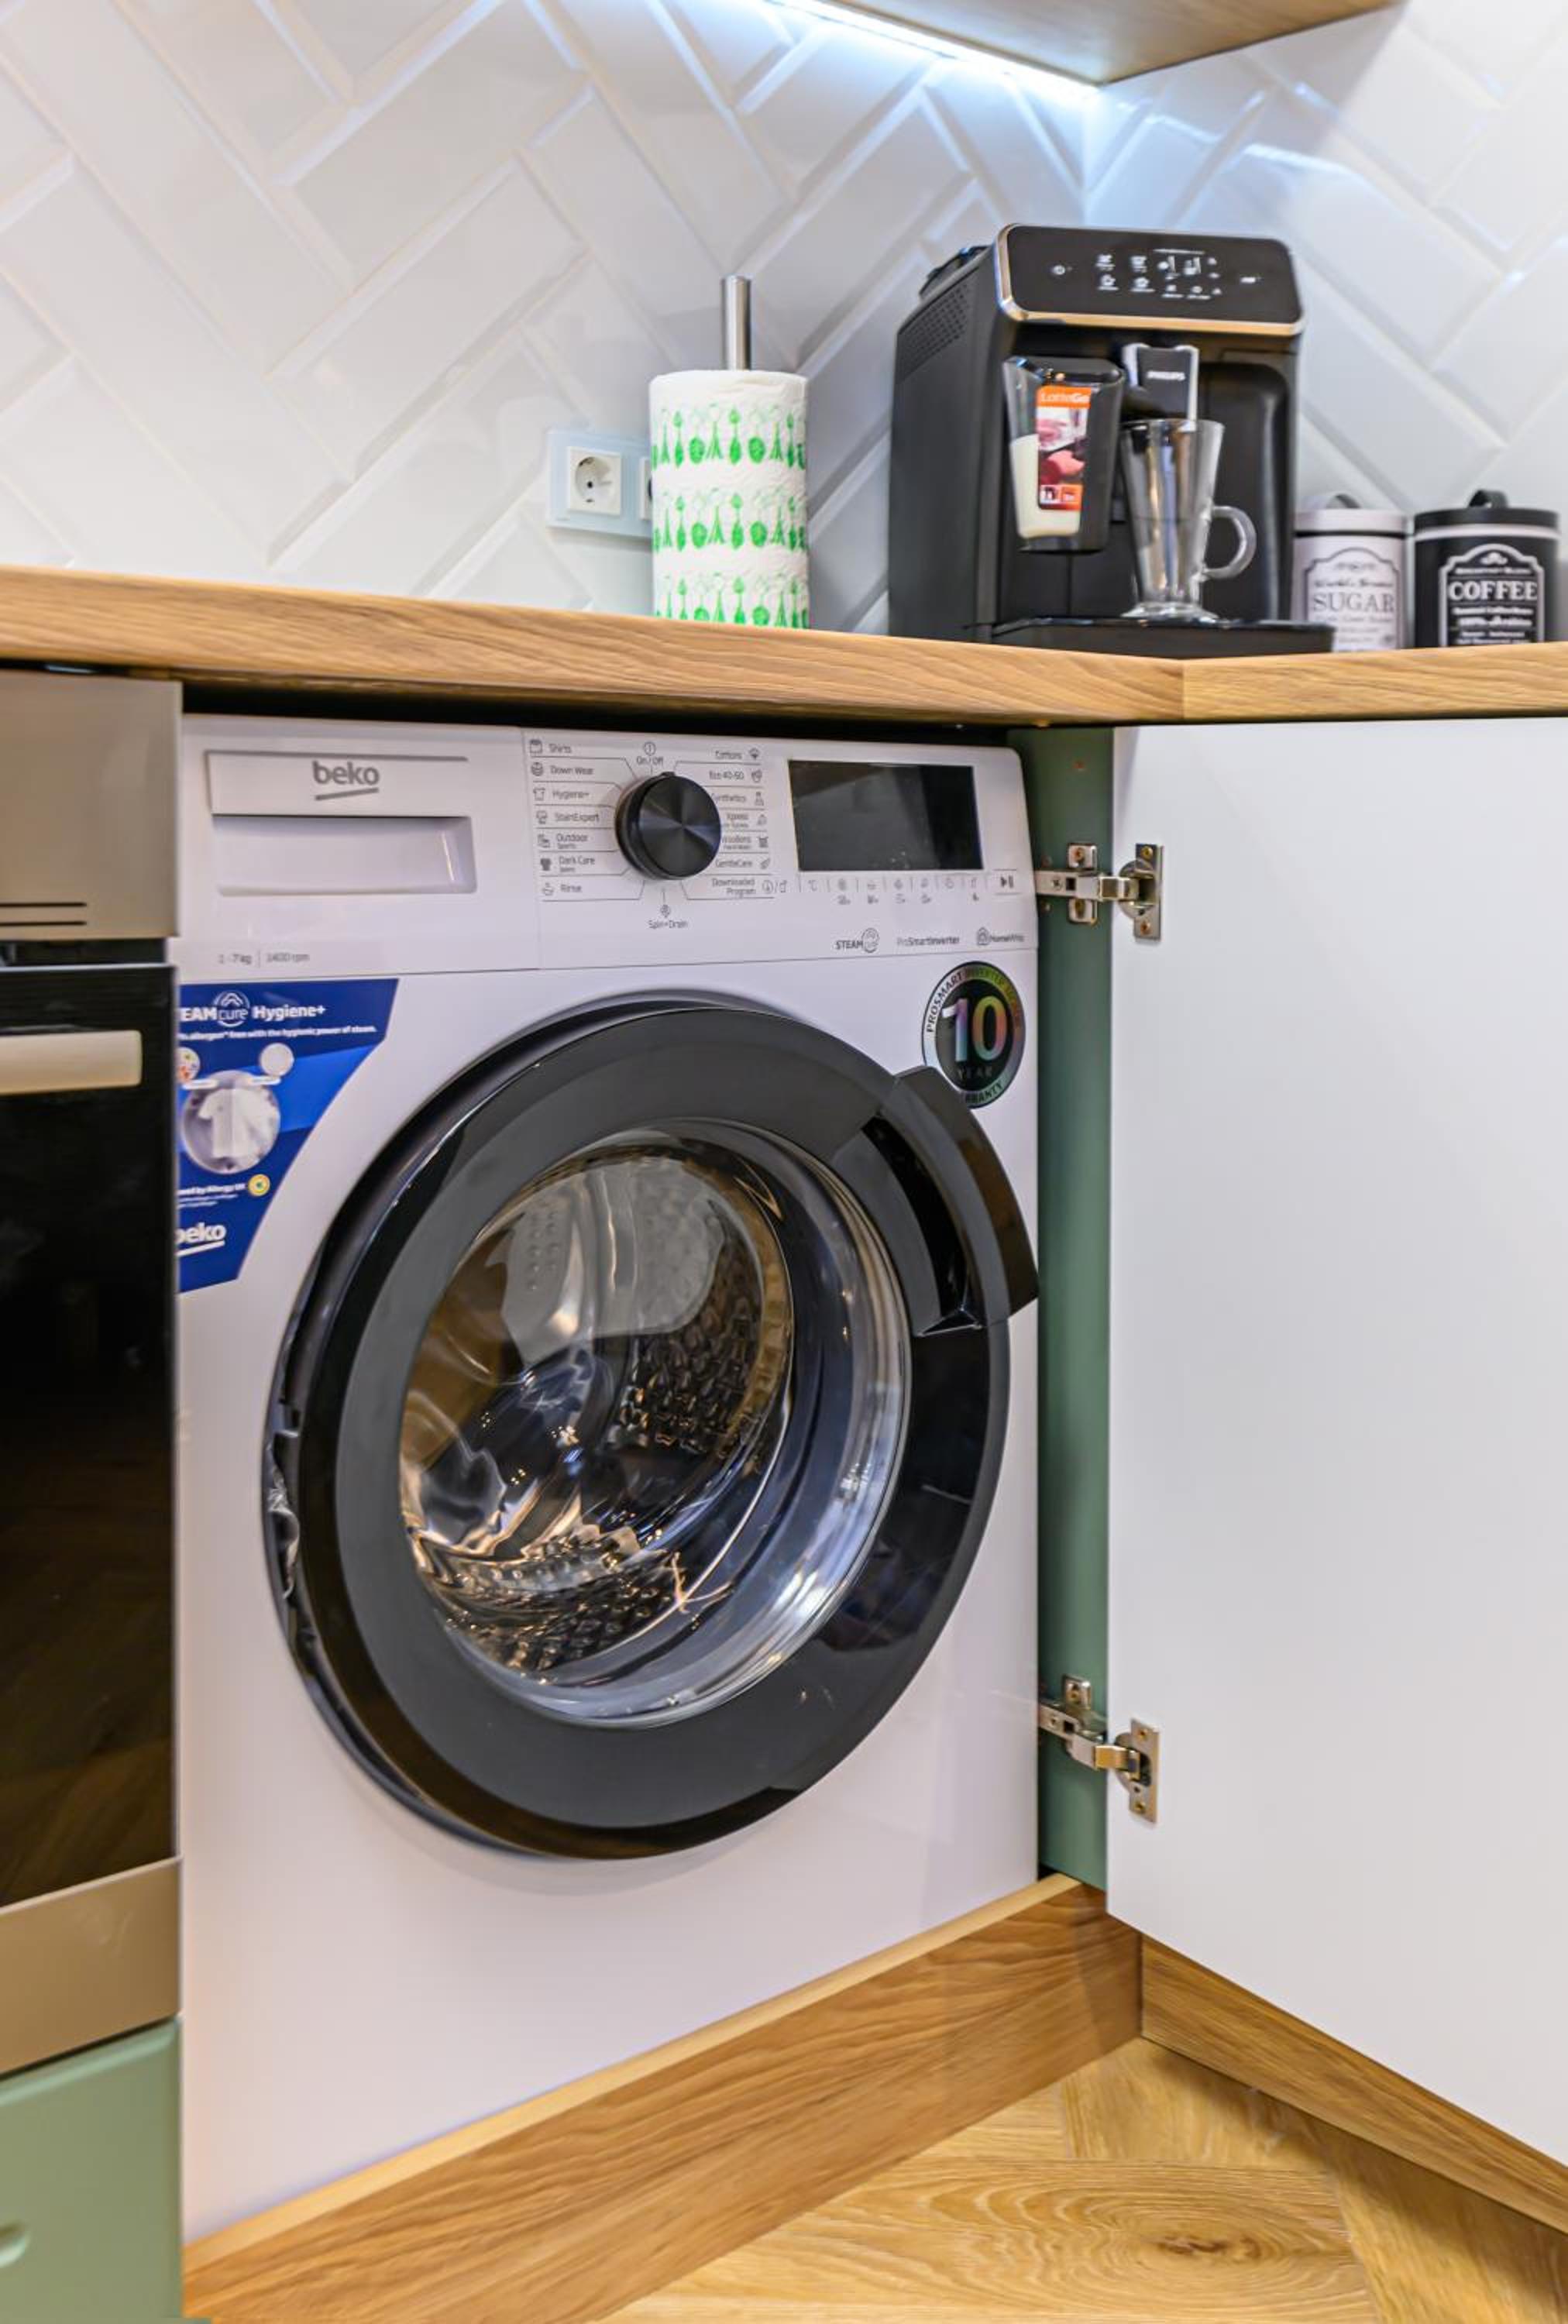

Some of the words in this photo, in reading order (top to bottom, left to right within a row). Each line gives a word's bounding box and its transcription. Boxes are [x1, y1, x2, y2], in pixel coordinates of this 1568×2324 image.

[1449, 580, 1538, 600] COFFEE
[1313, 592, 1395, 612] SUGAR
[312, 760, 380, 786] beko
[550, 765, 572, 775] Down
[556, 832, 589, 843] Outdoor
[926, 969, 964, 1033] PROSMART
[252, 1005, 325, 1022] Hygiene+
[941, 995, 1007, 1062] 10
[965, 1080, 1004, 1104] RRANTY
